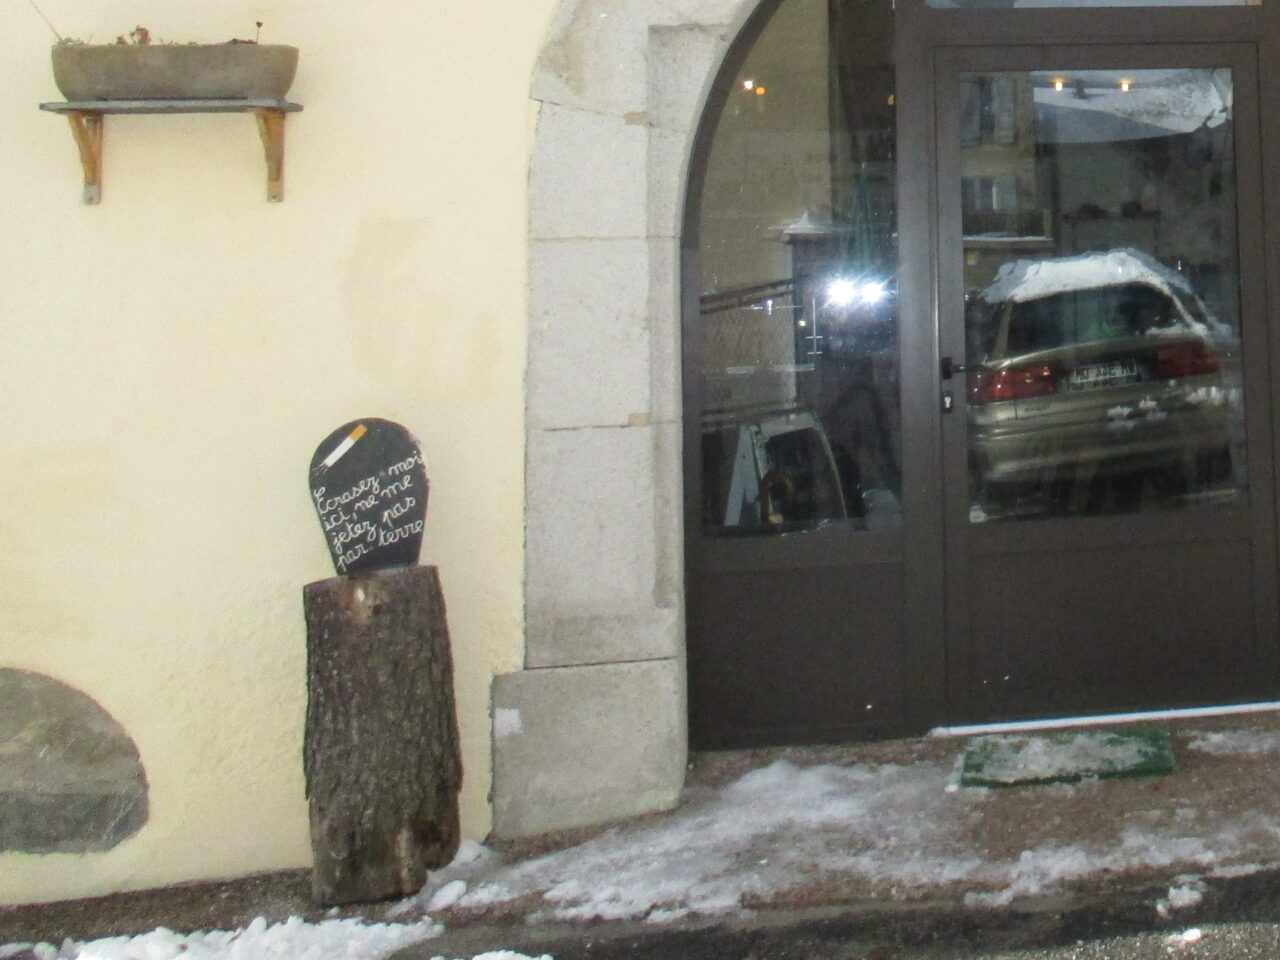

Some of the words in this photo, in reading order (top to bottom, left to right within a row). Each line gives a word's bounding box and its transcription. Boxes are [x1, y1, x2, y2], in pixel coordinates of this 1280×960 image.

[355, 495, 379, 511] ne
[381, 475, 413, 498] me
[332, 520, 377, 554] jetez
[383, 496, 415, 528] pas
[337, 543, 368, 572] par
[378, 519, 424, 546] terre
